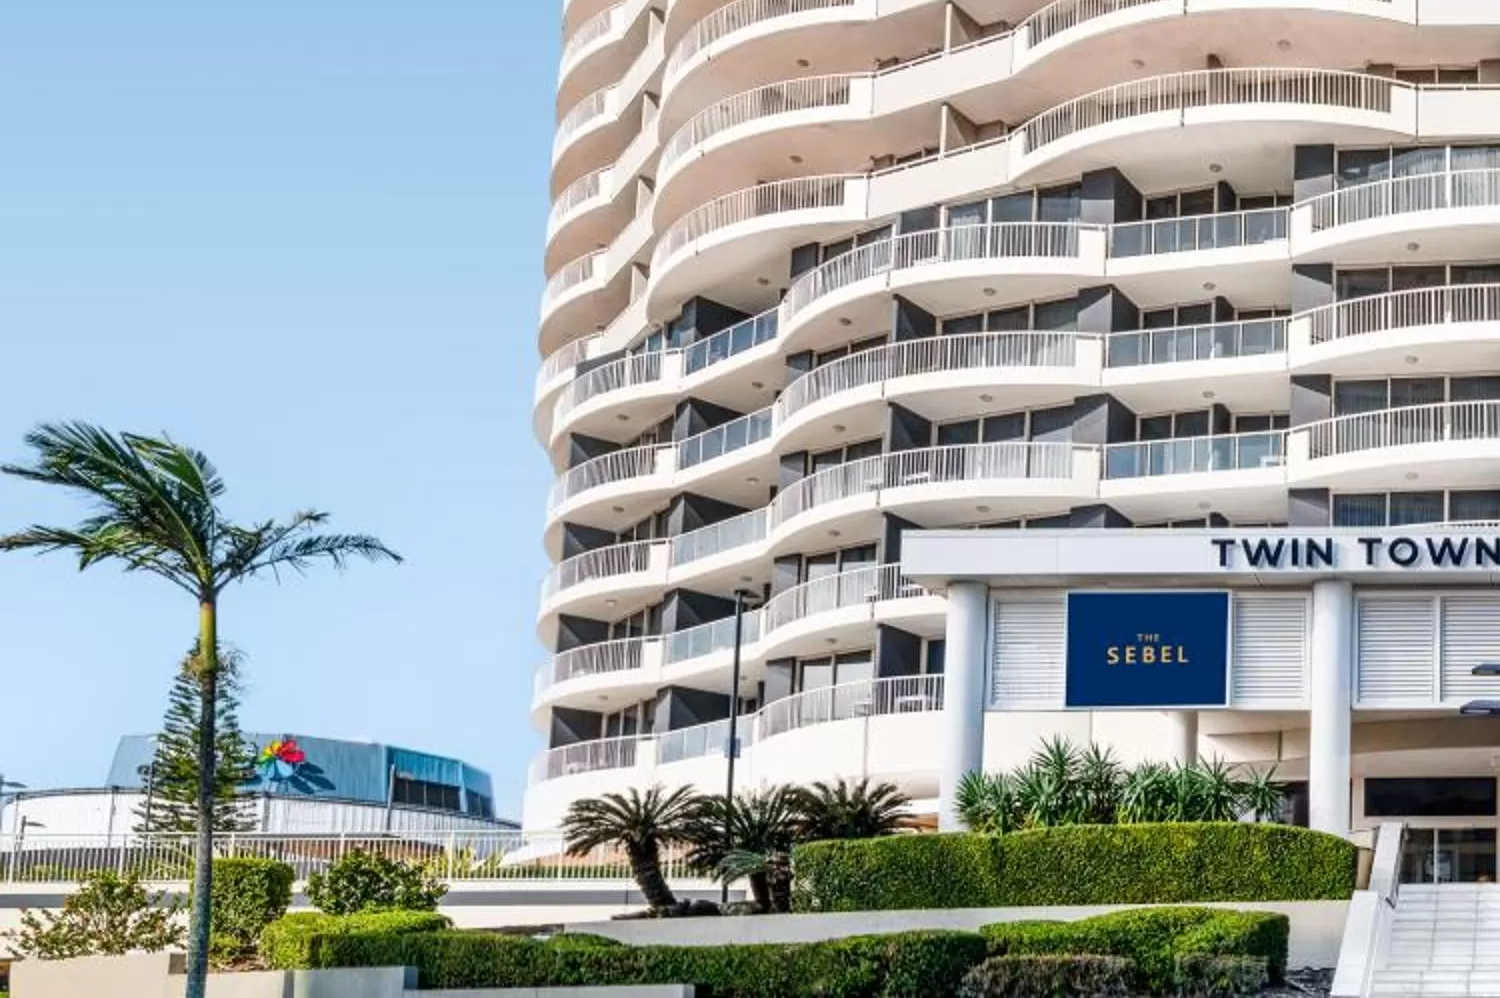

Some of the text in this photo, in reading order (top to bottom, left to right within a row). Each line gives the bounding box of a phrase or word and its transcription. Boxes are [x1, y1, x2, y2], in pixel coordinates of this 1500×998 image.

[1211, 537, 1334, 568] TWIN
[1136, 633, 1160, 643] THE
[1106, 645, 1190, 665] SEBEL
